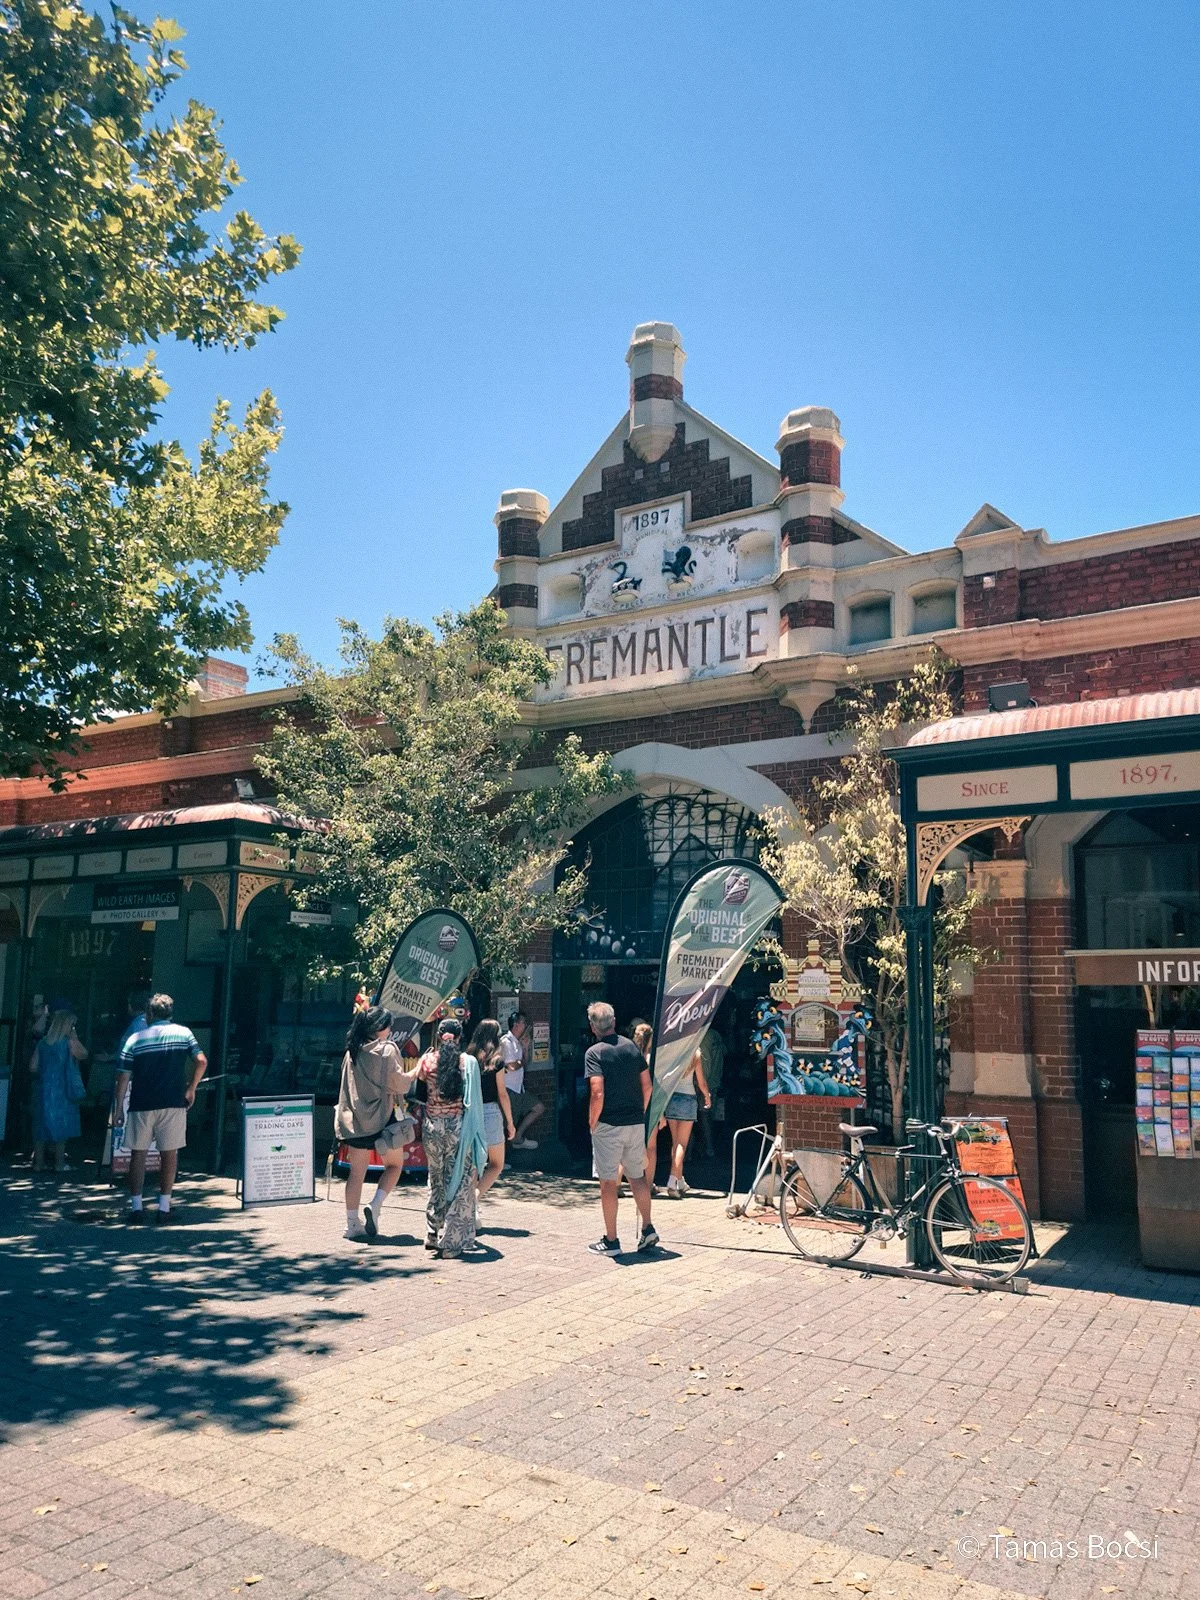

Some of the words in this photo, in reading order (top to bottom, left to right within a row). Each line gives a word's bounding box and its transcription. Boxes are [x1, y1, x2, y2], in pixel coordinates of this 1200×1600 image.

[632, 509, 670, 531] 1897
[545, 608, 768, 690] FREMANTLE
[961, 781, 1009, 797] SINCE
[97, 896, 117, 908] WILD
[118, 894, 144, 906] EARTH
[145, 892, 176, 904] IMAGES
[700, 899, 713, 909] THE
[690, 909, 746, 927] ORIGINAL
[71, 928, 121, 957] 1897
[711, 926, 745, 945] BEST
[408, 945, 449, 974] ORIGINAL
[420, 965, 448, 989] BEST
[390, 980, 433, 1008] FREMANTLE
[391, 992, 425, 1015] MARKETS
[255, 1122, 285, 1130] TRADING
